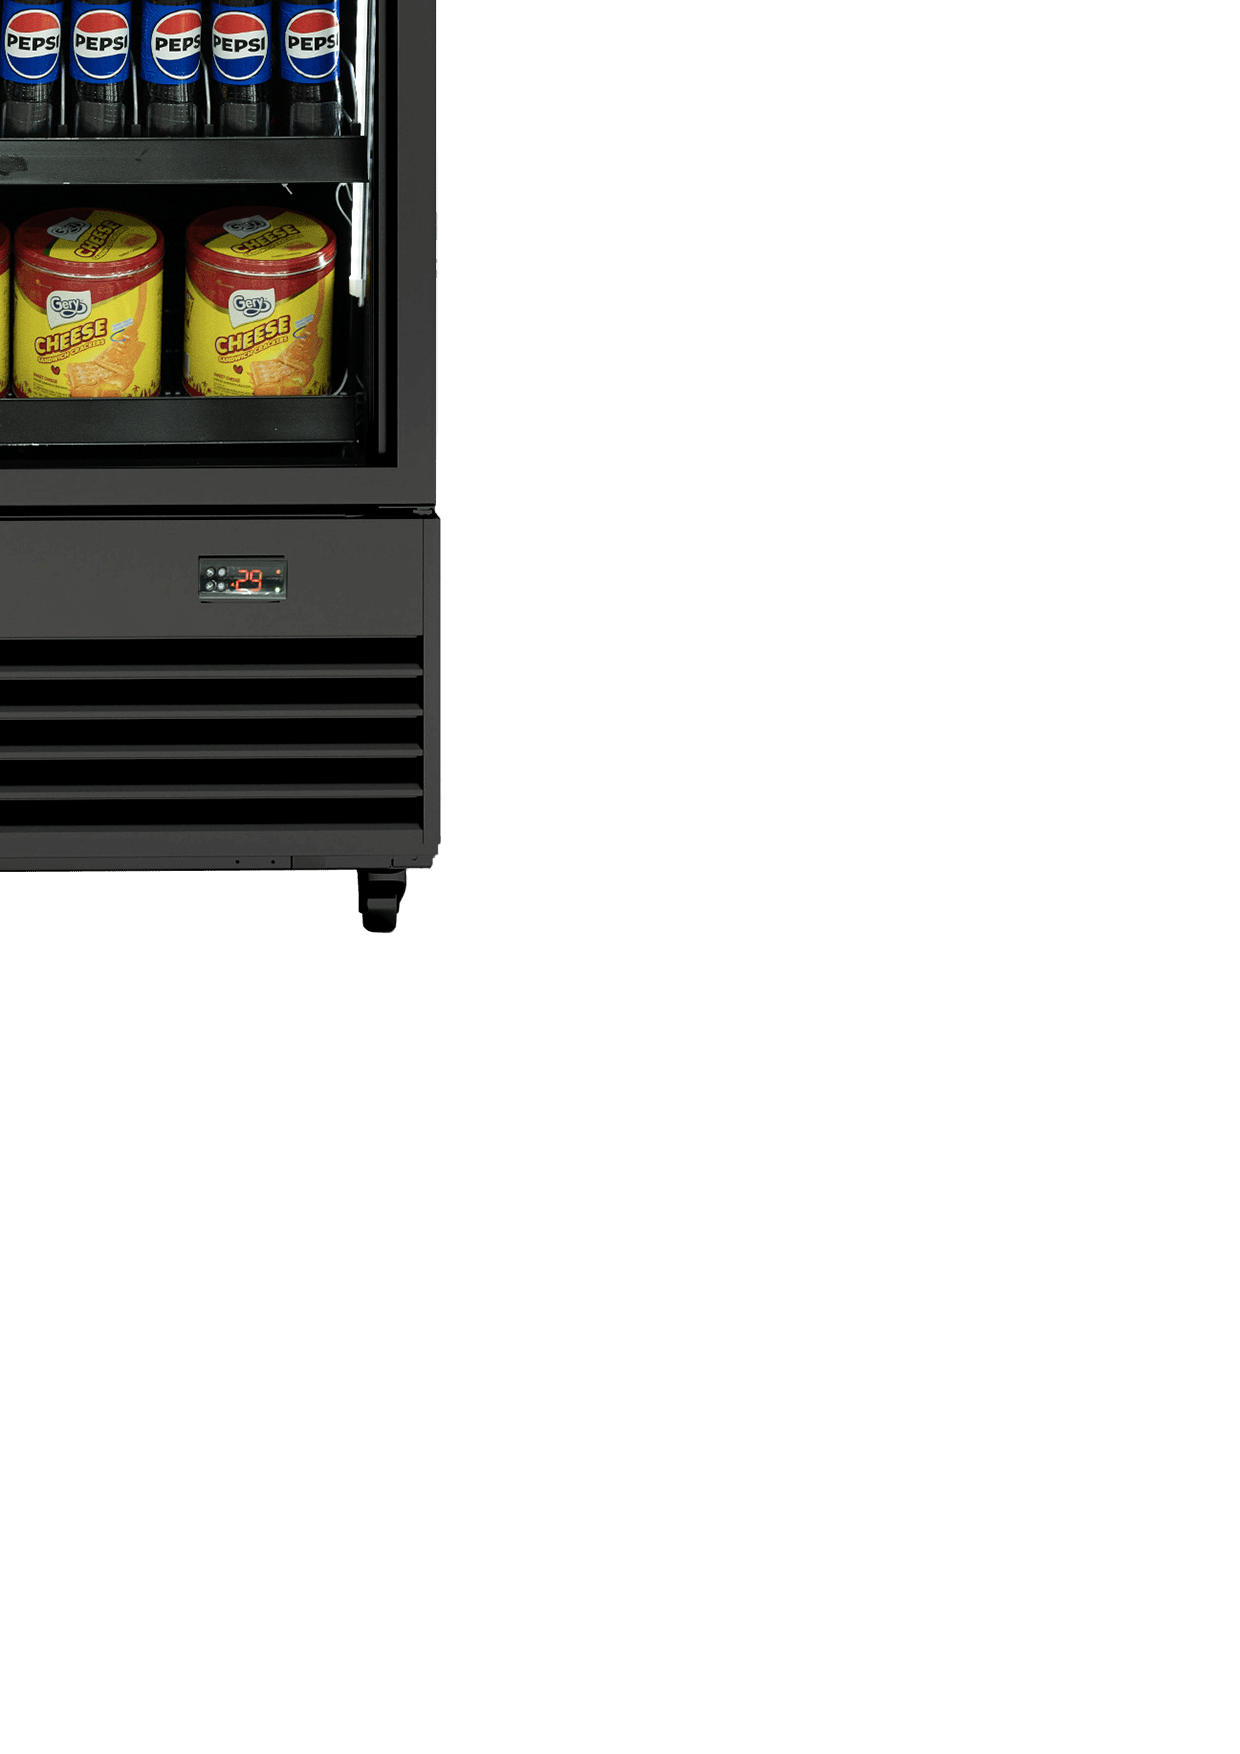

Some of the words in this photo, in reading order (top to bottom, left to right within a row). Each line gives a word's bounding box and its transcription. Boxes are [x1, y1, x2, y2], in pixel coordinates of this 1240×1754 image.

[75, 33, 128, 52] PEPSI
[155, 34, 201, 52] PEPS
[214, 34, 266, 53] PEPSI
[73, 219, 123, 258] CHEESE
[230, 224, 301, 254] CHEESE
[50, 295, 88, 319] Gery
[232, 294, 272, 317] Gery
[34, 317, 108, 356] CHEESE
[214, 314, 291, 356] CHEESE
[37, 351, 70, 364] SANDWICH
[217, 349, 253, 364] SANDWICH
[235, 569, 263, 592] 29
